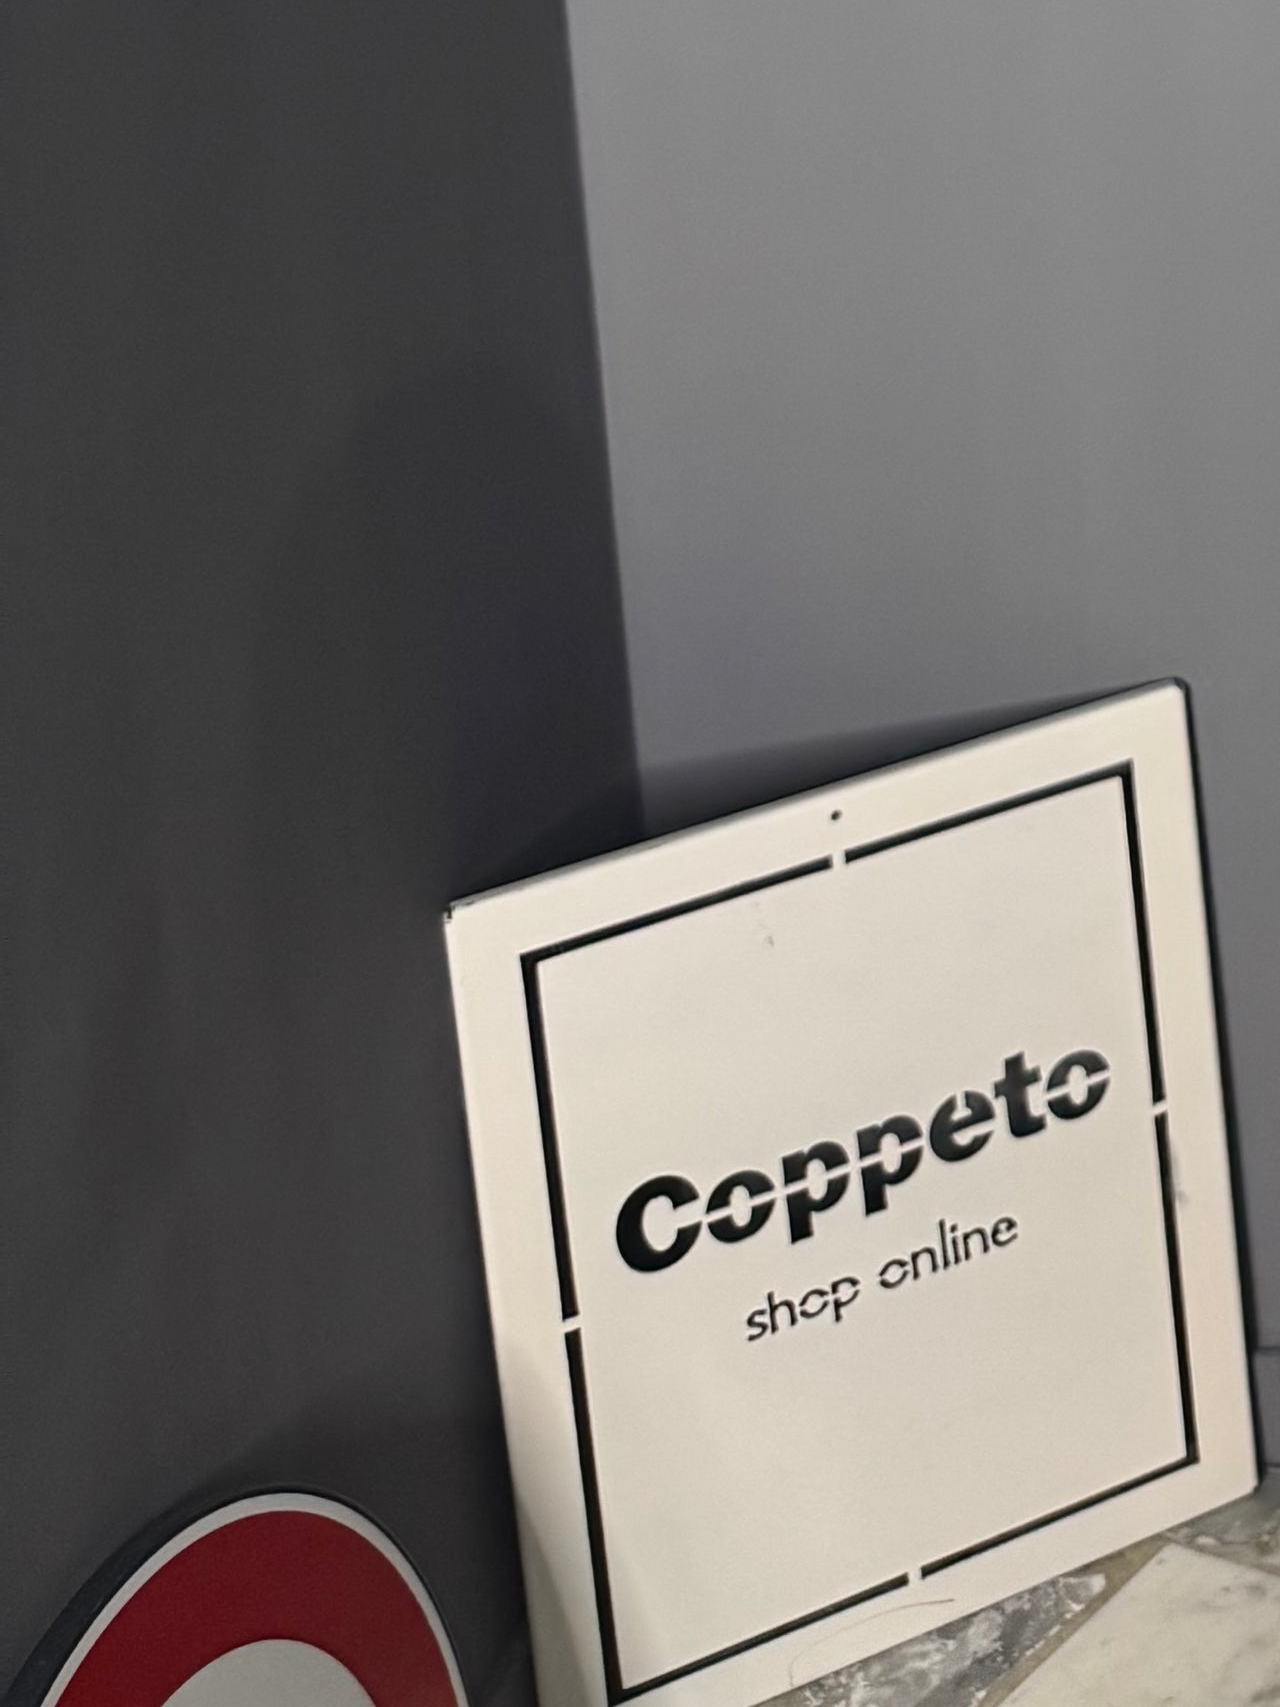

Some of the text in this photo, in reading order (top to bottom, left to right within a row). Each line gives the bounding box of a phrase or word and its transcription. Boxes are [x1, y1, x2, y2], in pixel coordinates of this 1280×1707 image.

[615, 1046, 1112, 1274] Coppeto
[745, 1212, 1020, 1343] shop online
